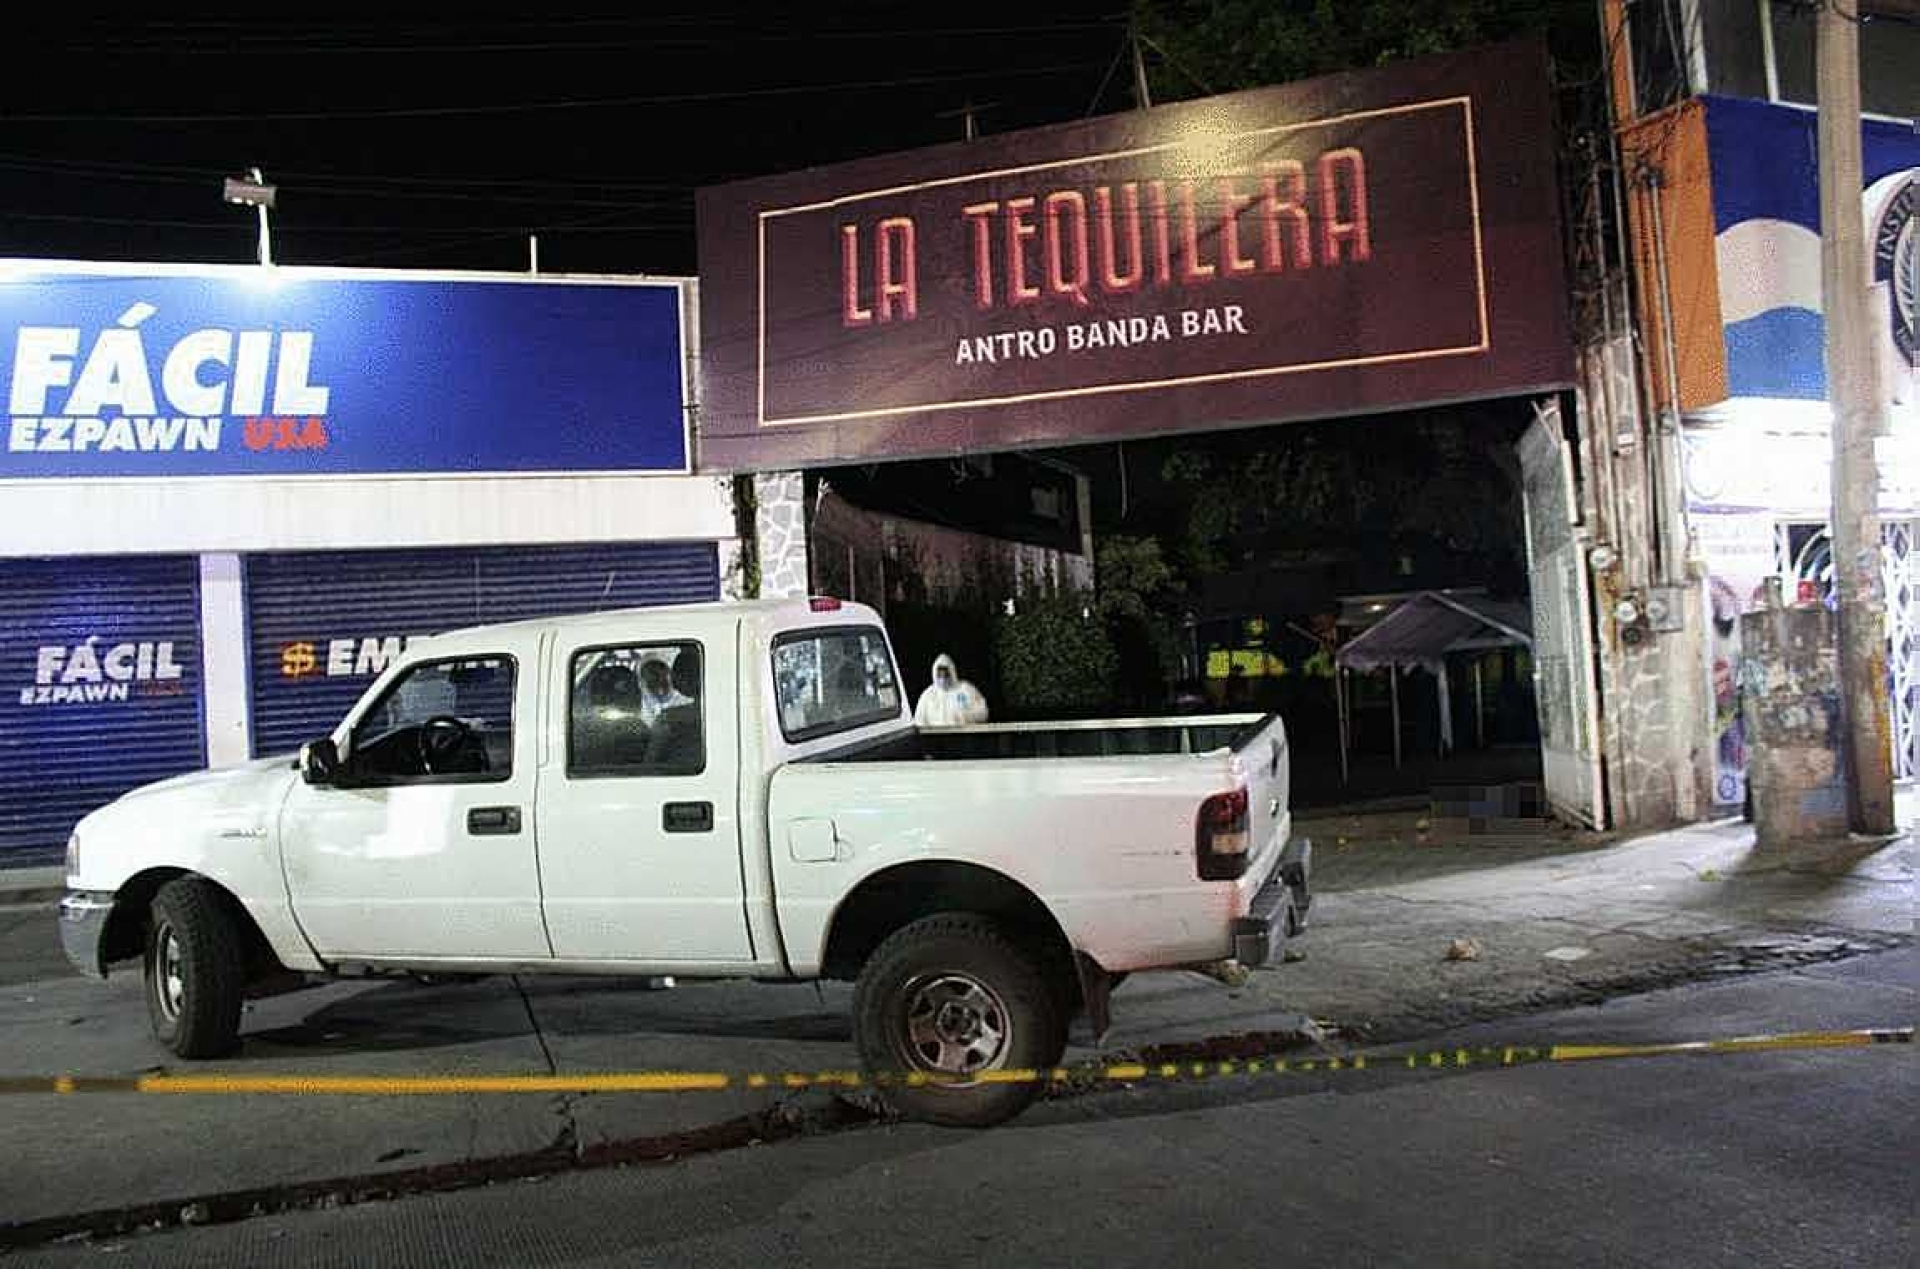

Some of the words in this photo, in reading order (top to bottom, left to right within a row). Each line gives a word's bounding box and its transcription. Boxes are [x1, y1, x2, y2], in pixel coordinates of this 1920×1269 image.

[841, 216, 918, 328] LA
[962, 146, 1372, 311] TEQUILERA
[10, 302, 330, 416] FÁCIL
[955, 327, 1057, 365] ANTRO
[1067, 316, 1171, 350] BANDA
[1181, 305, 1249, 336] BAR
[10, 417, 221, 451] EZPAWN
[243, 417, 329, 450] USA
[36, 636, 183, 683] FÁCIL
[20, 683, 129, 704] EZPAWN
